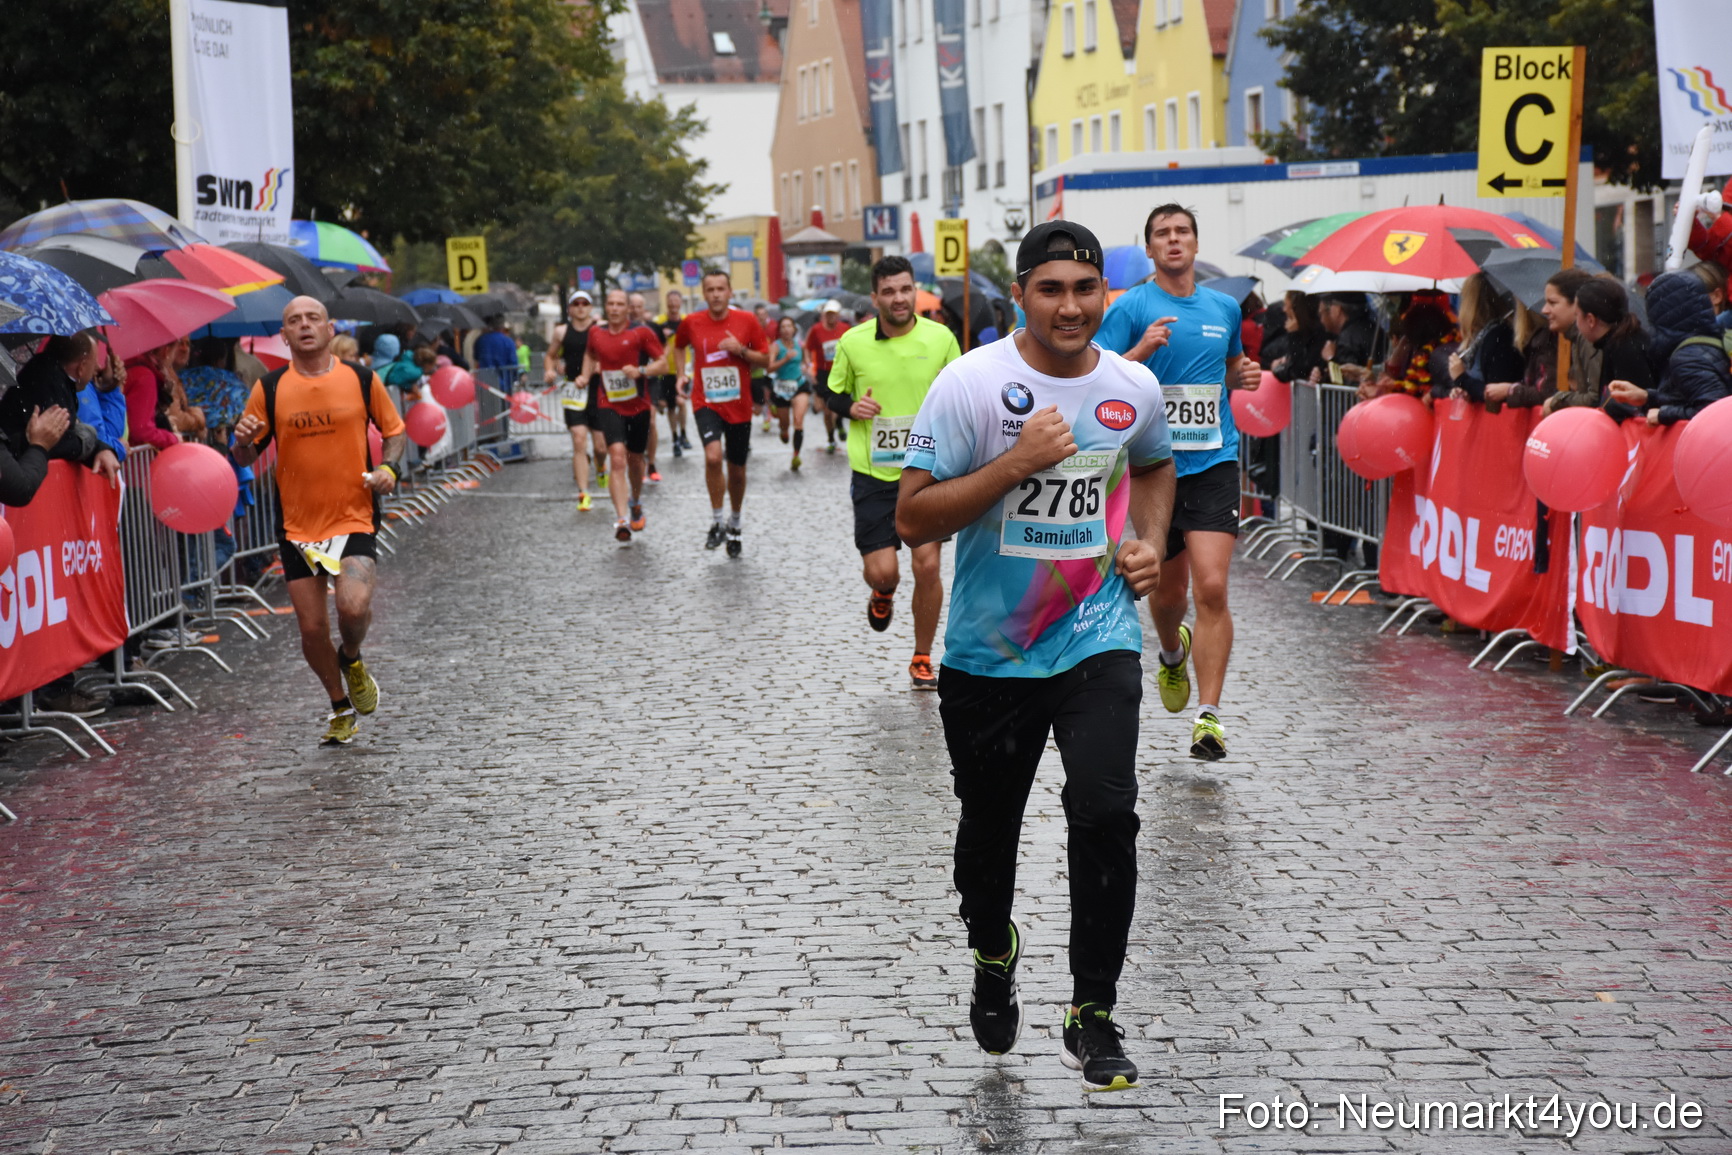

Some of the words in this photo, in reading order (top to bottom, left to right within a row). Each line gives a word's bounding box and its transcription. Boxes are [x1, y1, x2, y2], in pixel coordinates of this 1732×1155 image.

[1494, 54, 1572, 80] Block
[1504, 92, 1556, 166] C
[196, 174, 253, 211] swn
[944, 236, 960, 263] D
[458, 254, 477, 282] D
[609, 378, 629, 390] 298
[706, 374, 737, 391] 2546
[1003, 383, 1030, 394] BMW
[1101, 406, 1132, 423] Hervis
[1165, 400, 1216, 424] 2693
[1172, 431, 1209, 441] Matthias
[1062, 454, 1109, 468] BOCK
[1017, 477, 1102, 518] 2785
[1023, 527, 1093, 546] Samiullah
